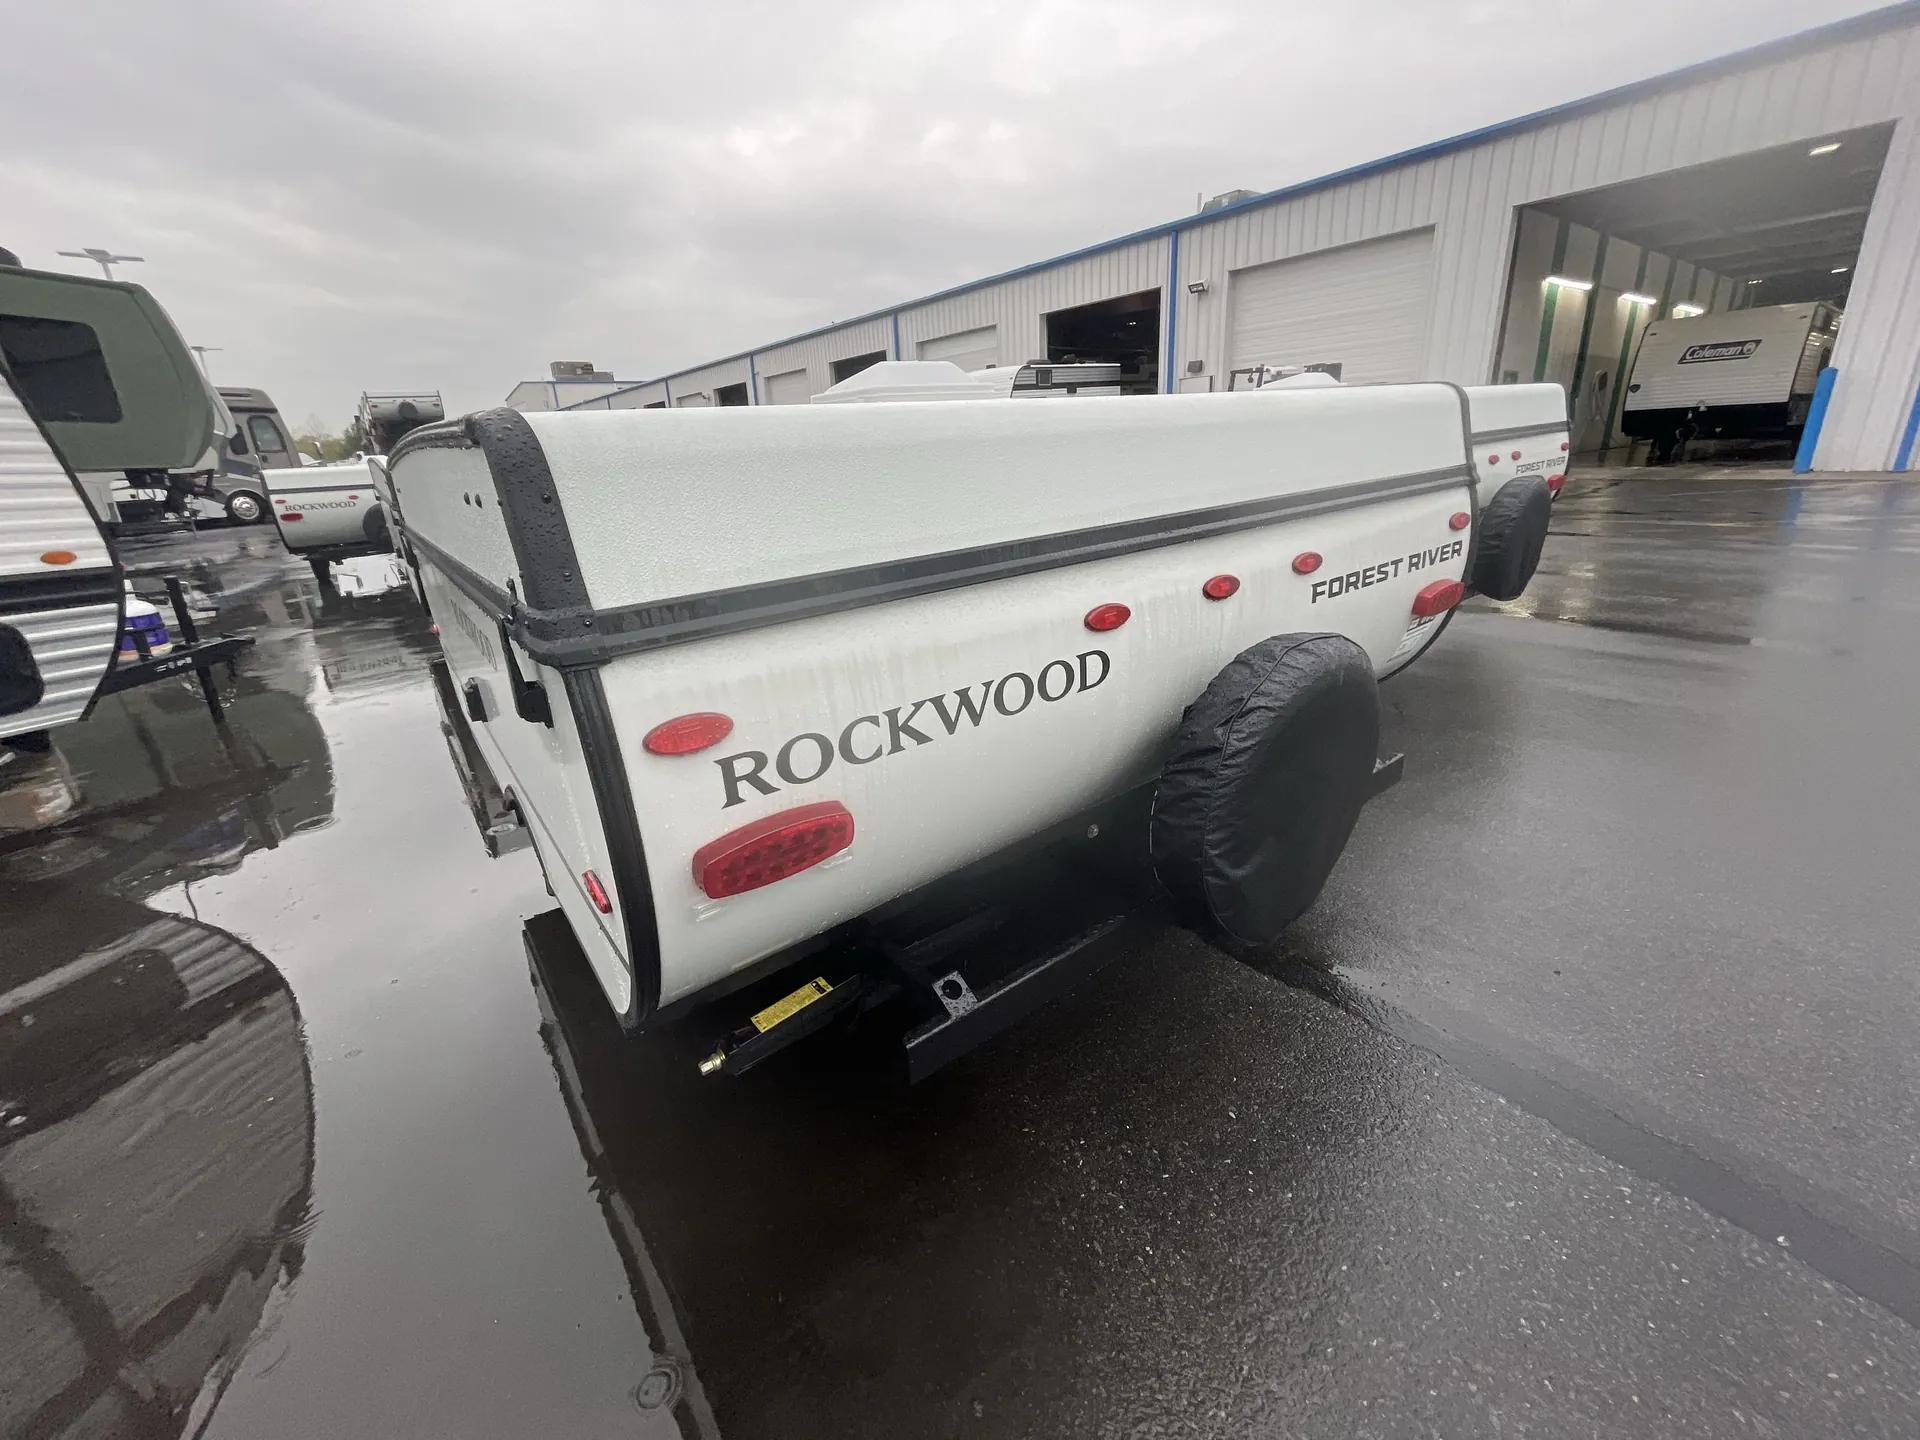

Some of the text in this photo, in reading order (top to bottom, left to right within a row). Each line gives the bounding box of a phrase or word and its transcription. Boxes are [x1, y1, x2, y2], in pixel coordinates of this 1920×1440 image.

[1687, 346, 1741, 360] Coleman
[1516, 456, 1566, 475] FOREST RIVER
[285, 501, 356, 511] ROCKWOOD
[1311, 540, 1463, 604] FOREST RIVER
[714, 649, 1111, 810] ROCKWOOD
